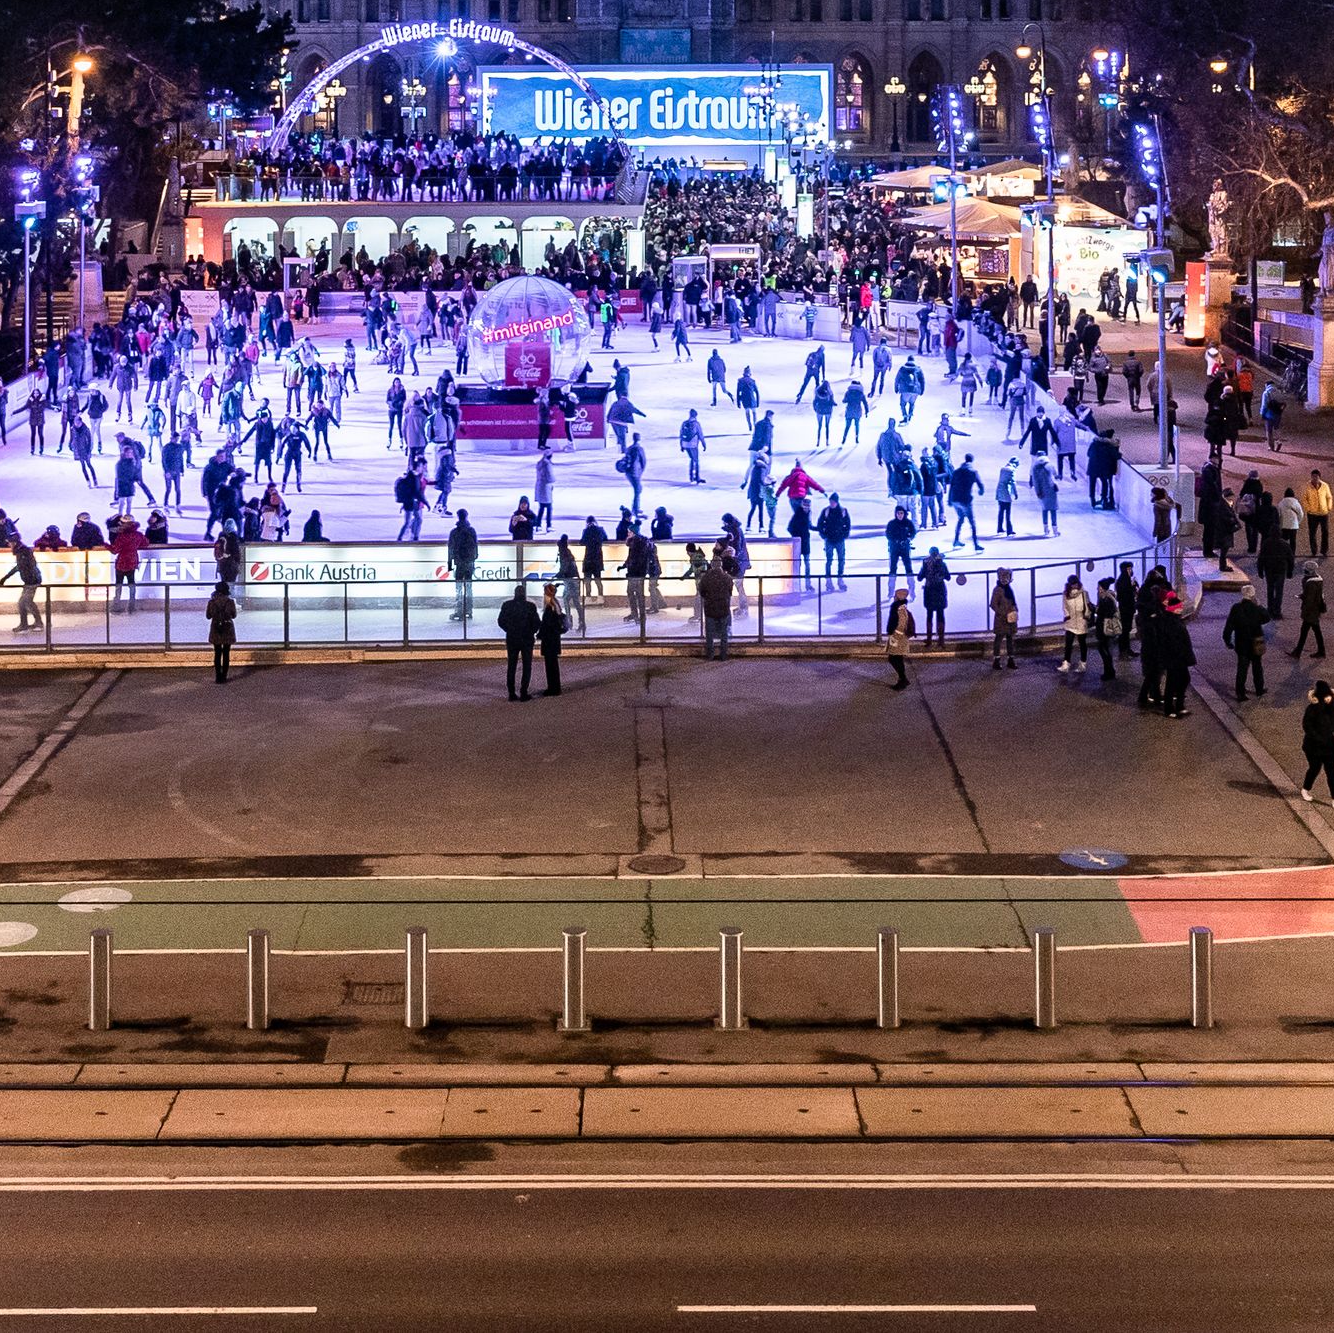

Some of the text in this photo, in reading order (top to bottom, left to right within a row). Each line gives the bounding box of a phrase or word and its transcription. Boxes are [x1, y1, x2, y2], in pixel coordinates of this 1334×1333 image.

[381, 18, 514, 47] Wiener Eistraum
[534, 87, 777, 131] Wiener Eistraum
[1079, 246, 1100, 260] Bio
[39, 557, 105, 582] DIO
[272, 564, 315, 581] Bank
[319, 563, 377, 581] Austria
[453, 565, 512, 580] Credit
